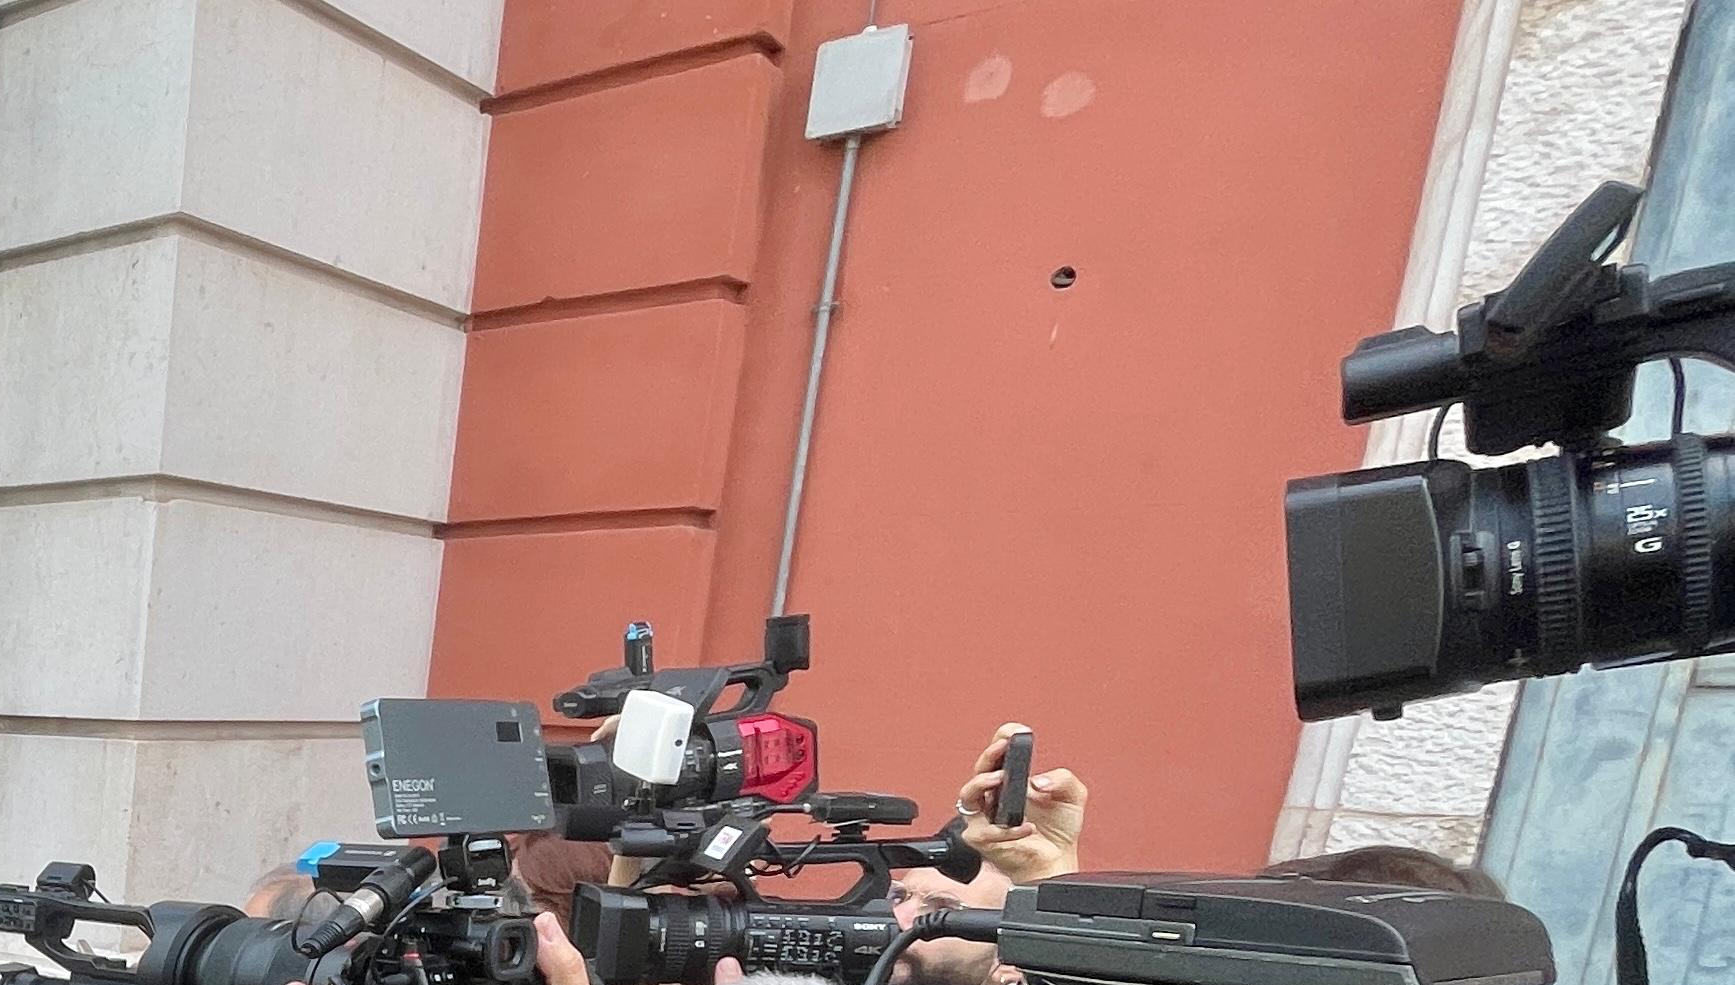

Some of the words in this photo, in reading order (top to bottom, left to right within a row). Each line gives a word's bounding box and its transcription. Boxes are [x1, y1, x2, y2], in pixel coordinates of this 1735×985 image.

[1634, 537, 1663, 553] G
[392, 779, 435, 791] ENEGON
[853, 922, 886, 931] SONY
[854, 944, 882, 956] 4K
